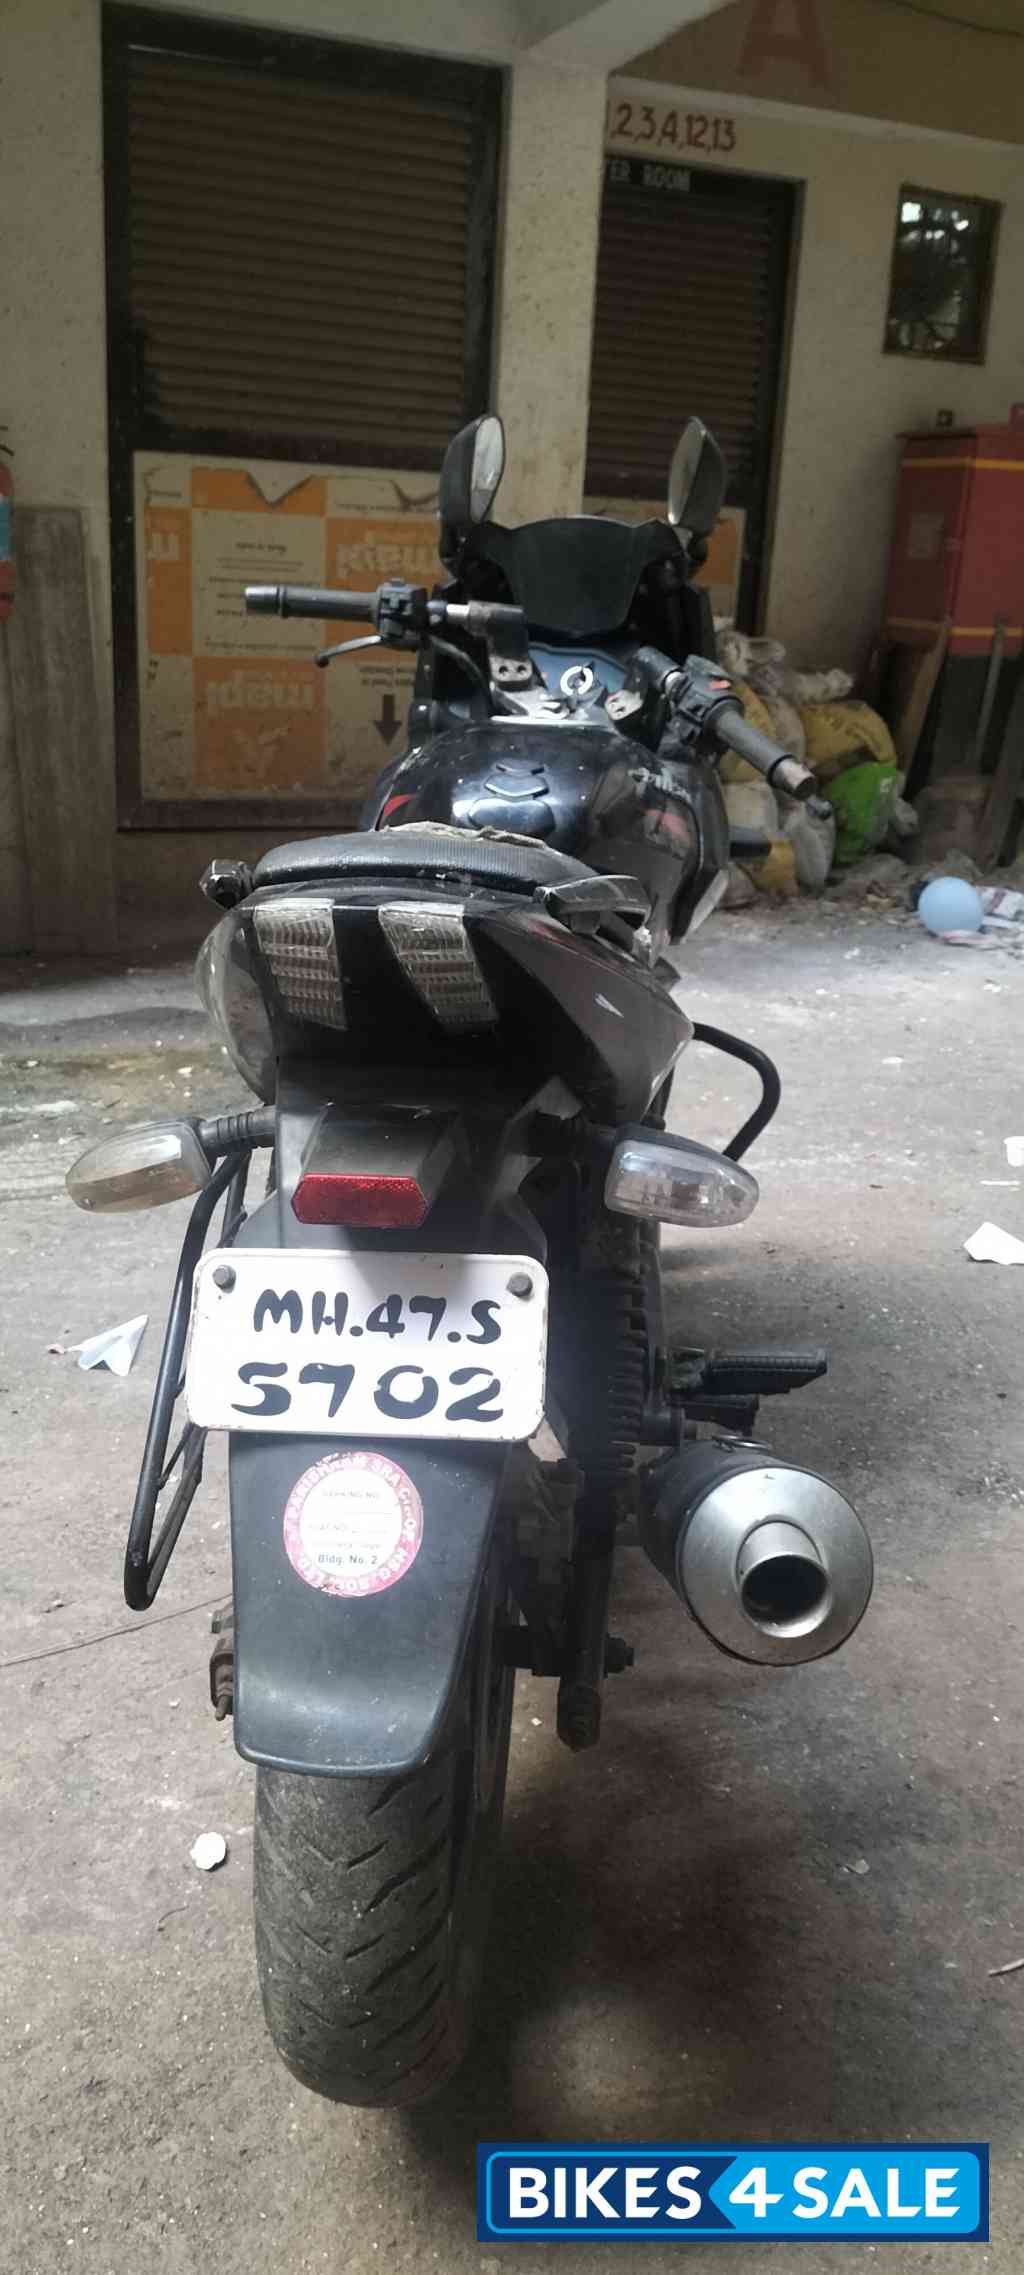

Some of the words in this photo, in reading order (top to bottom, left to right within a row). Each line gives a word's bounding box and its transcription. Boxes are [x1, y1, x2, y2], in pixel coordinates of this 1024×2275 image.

[643, 164, 693, 193] ROOM
[253, 1288, 501, 1345] MH.47.S
[230, 1362, 503, 1423] 5702
[371, 1554, 378, 1565] 2
